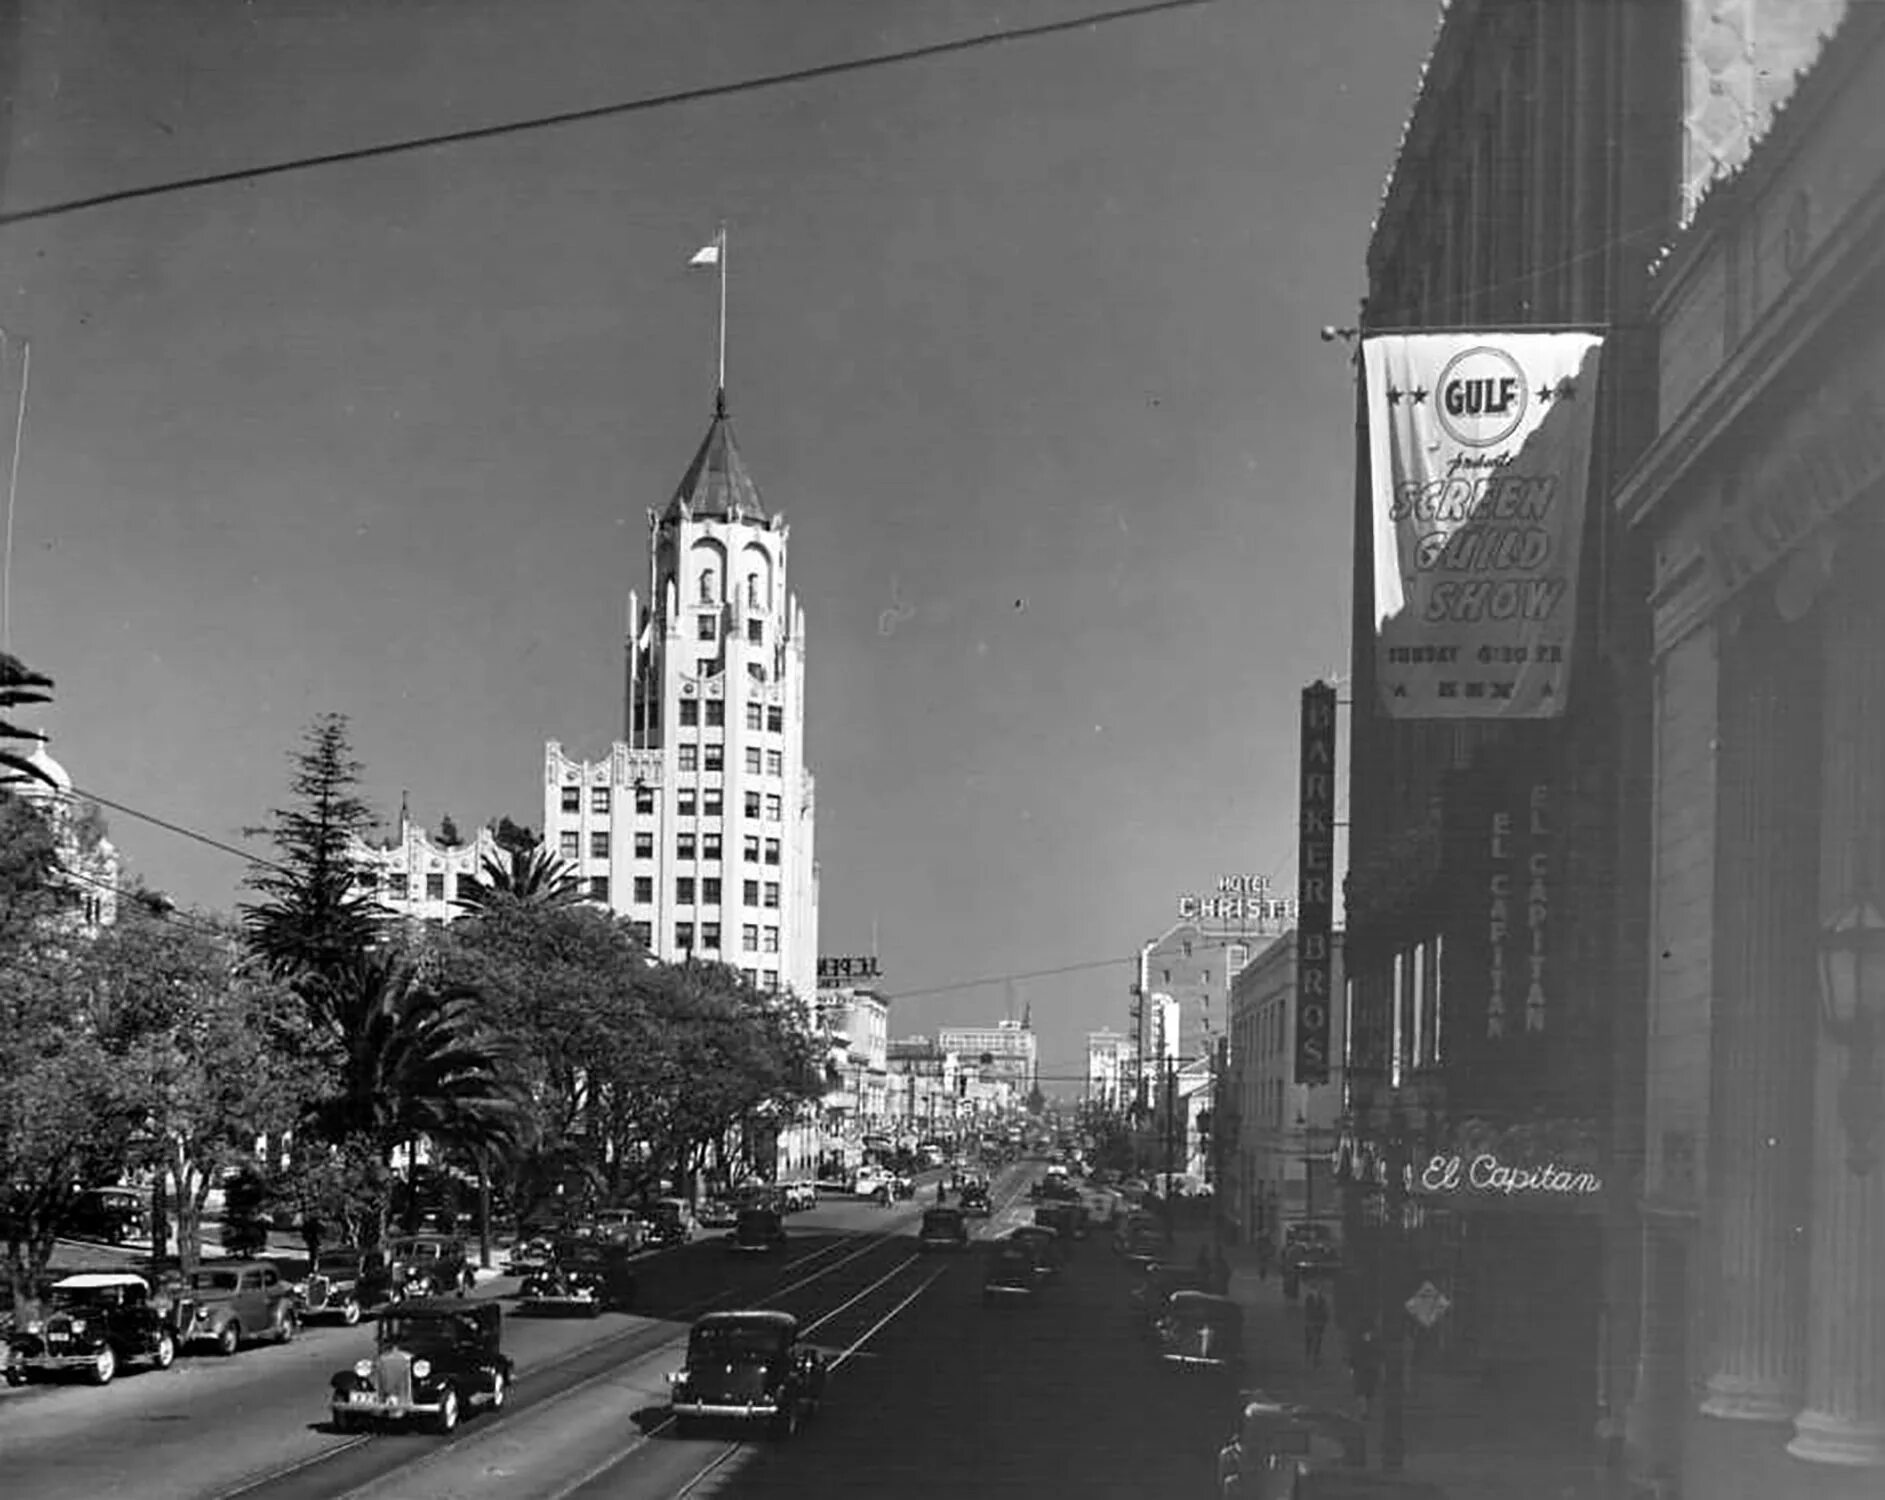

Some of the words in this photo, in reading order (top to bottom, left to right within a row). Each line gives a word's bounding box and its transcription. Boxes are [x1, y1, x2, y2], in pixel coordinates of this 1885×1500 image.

[1444, 377, 1517, 416] GULF
[1389, 476, 1557, 522] SCREEN
[1414, 527, 1549, 571] GUILD
[1425, 578, 1566, 622] SHOW
[1303, 702, 1330, 903] BARKER
[1218, 875, 1272, 892] HOTEL
[1179, 897, 1299, 919] CHRISTI
[1486, 874, 1509, 1040] CAPITAN
[1525, 853, 1549, 1033] CAPITAN
[1302, 933, 1327, 1062] BROS
[1421, 1154, 1461, 1191] El
[1469, 1153, 1600, 1195] Capitan
